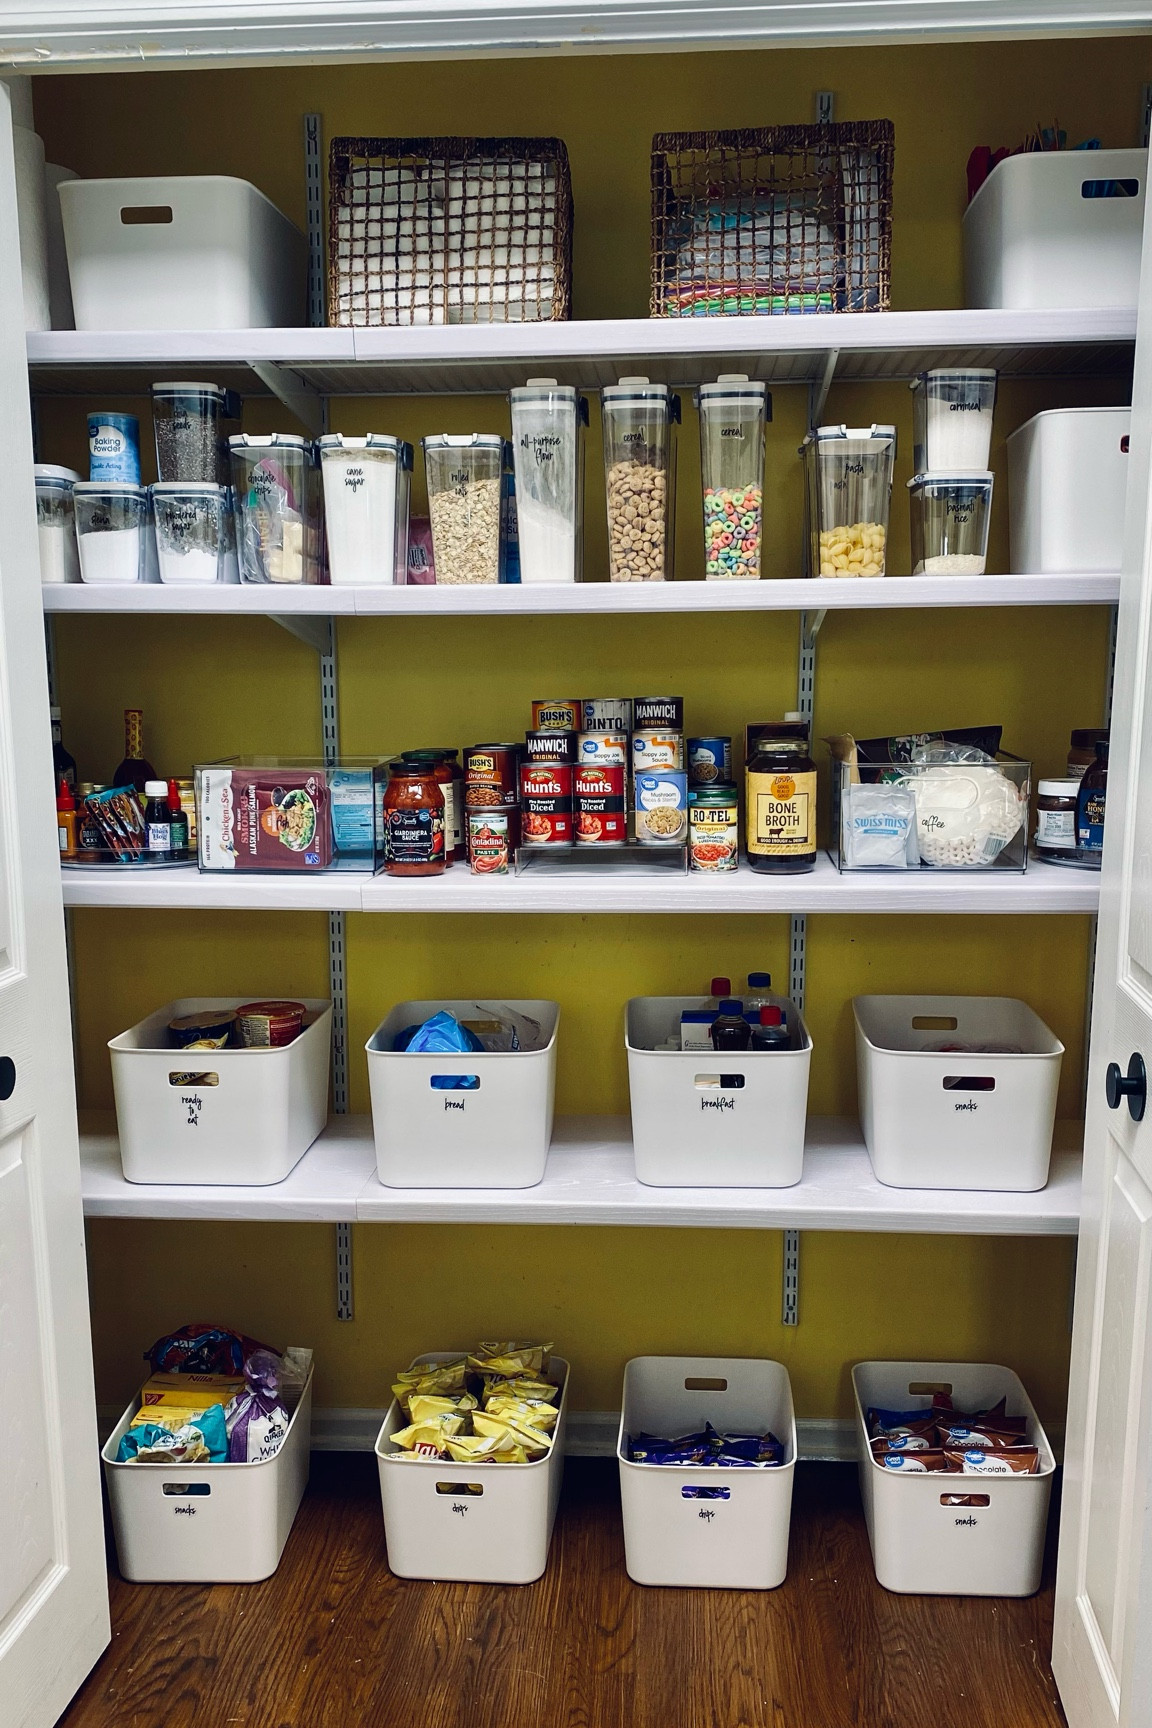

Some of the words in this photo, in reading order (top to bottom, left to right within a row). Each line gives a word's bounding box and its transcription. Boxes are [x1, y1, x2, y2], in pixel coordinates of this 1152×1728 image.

[949, 400, 981, 412] cornmeal
[172, 420, 192, 430] seeds
[721, 424, 743, 438] cereal
[623, 430, 645, 442] cereal
[93, 444, 122, 453] Powder
[94, 438, 121, 448] Baking
[520, 436, 561, 452] all-purpose
[534, 450, 554, 466] flour
[346, 466, 364, 476] cane
[450, 470, 470, 482] rolled
[844, 462, 864, 480] pasta
[248, 472, 276, 484] chocolate
[344, 476, 366, 493] sugar
[254, 486, 272, 501] chips
[946, 500, 974, 515] basmati
[165, 509, 198, 525] powdered
[954, 514, 968, 524] rice
[540, 710, 572, 723] BUSH'S
[636, 704, 676, 720] MANWICH
[586, 718, 623, 730] PINTO
[528, 738, 568, 754] MANWICH
[468, 758, 492, 768] BUSH'S
[524, 781, 561, 793] Hunt's
[576, 780, 612, 793] Hunt's
[769, 803, 797, 813] BONE
[221, 809, 230, 842] Chicken
[766, 816, 800, 826] BROTH
[854, 818, 882, 828] SWISS
[922, 815, 945, 834] coffee
[249, 828, 257, 855] ALASKAN
[471, 837, 503, 846] Contadina
[182, 1094, 202, 1110] ready
[444, 1098, 464, 1111] bread
[701, 1097, 735, 1112] breakfast
[954, 1099, 978, 1112] snacks
[188, 1104, 194, 1116] to
[188, 1114, 199, 1126] eat
[264, 1430, 284, 1443] QUAKER
[174, 1504, 196, 1516] snacks
[452, 1502, 469, 1517] chips
[698, 1509, 716, 1522] chips
[955, 1515, 978, 1527] snacks
